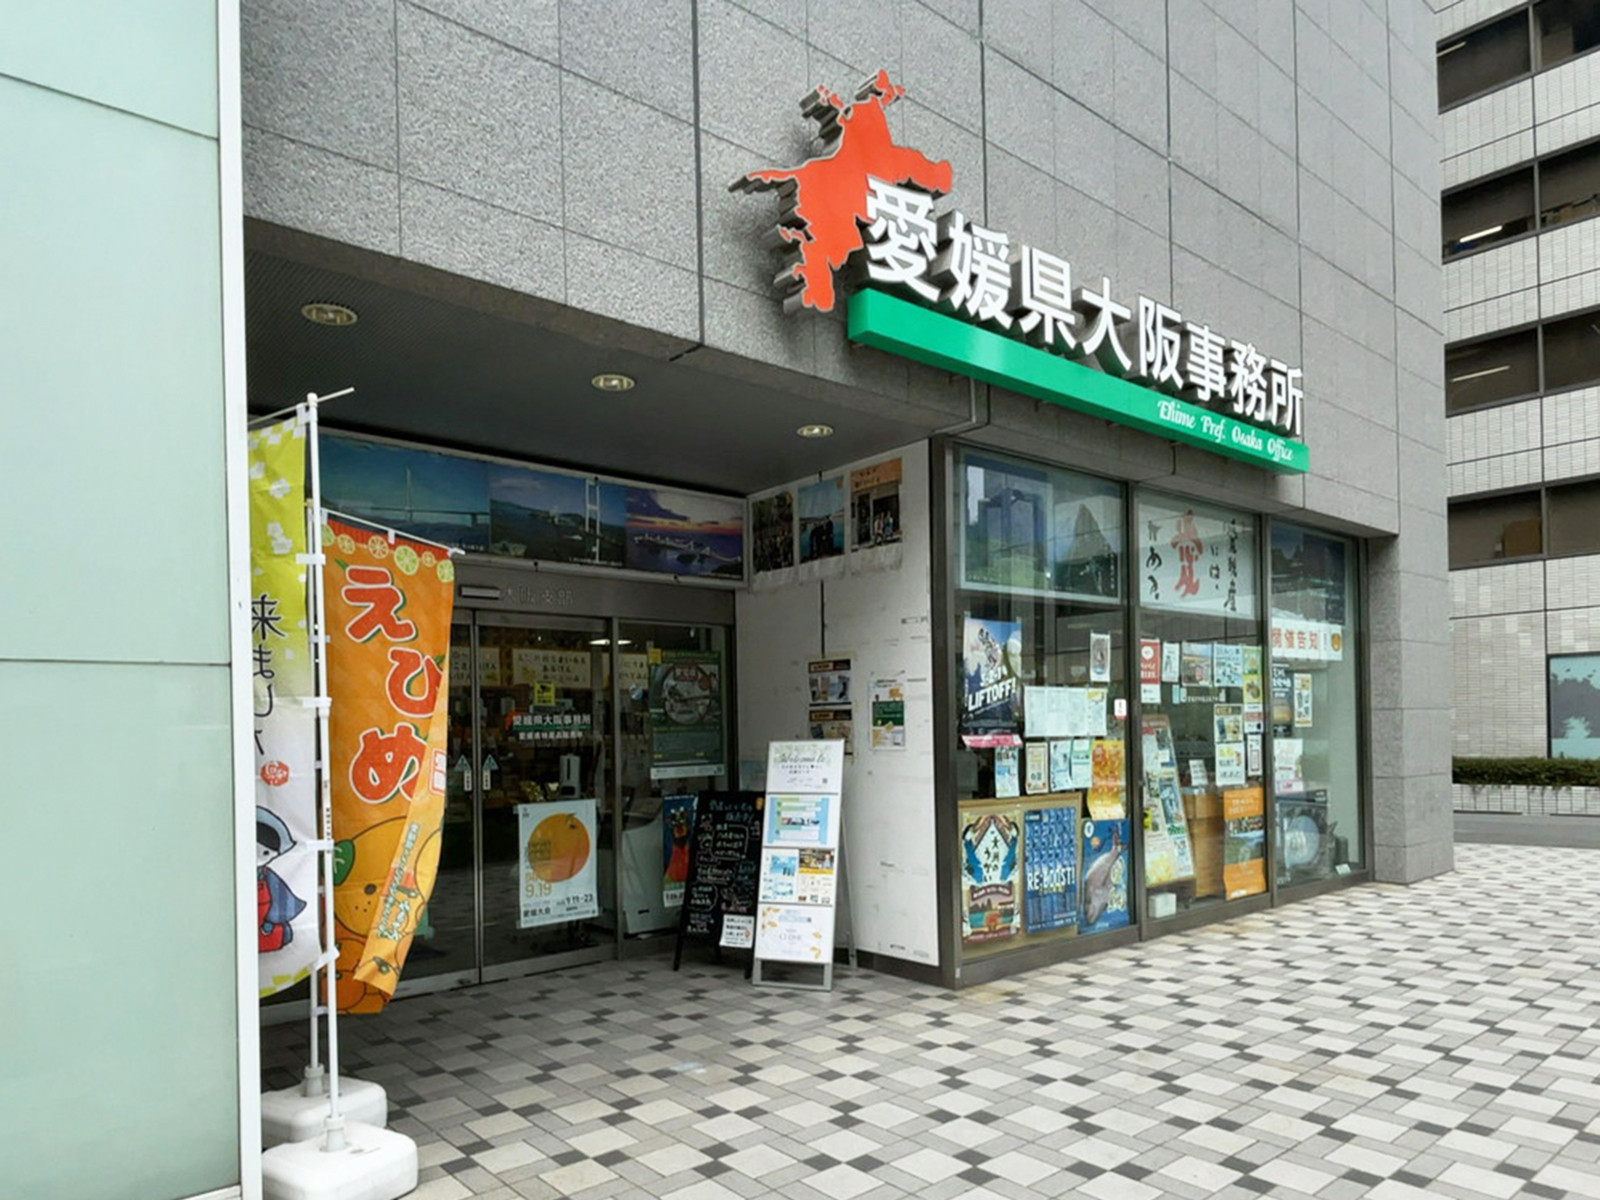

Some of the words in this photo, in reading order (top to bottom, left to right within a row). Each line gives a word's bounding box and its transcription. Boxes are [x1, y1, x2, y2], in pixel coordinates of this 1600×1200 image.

[866, 176, 1304, 438] 愛媛県大阪事務所
[1157, 400, 1197, 429] Ehime
[1201, 415, 1226, 443] Pref.
[1232, 426, 1263, 451] Osaka
[1267, 438, 1294, 462] Office
[342, 565, 444, 805] えひめ
[968, 677, 1017, 712] LIFTOFF!
[513, 713, 591, 726] 愛媛県大阪事務所
